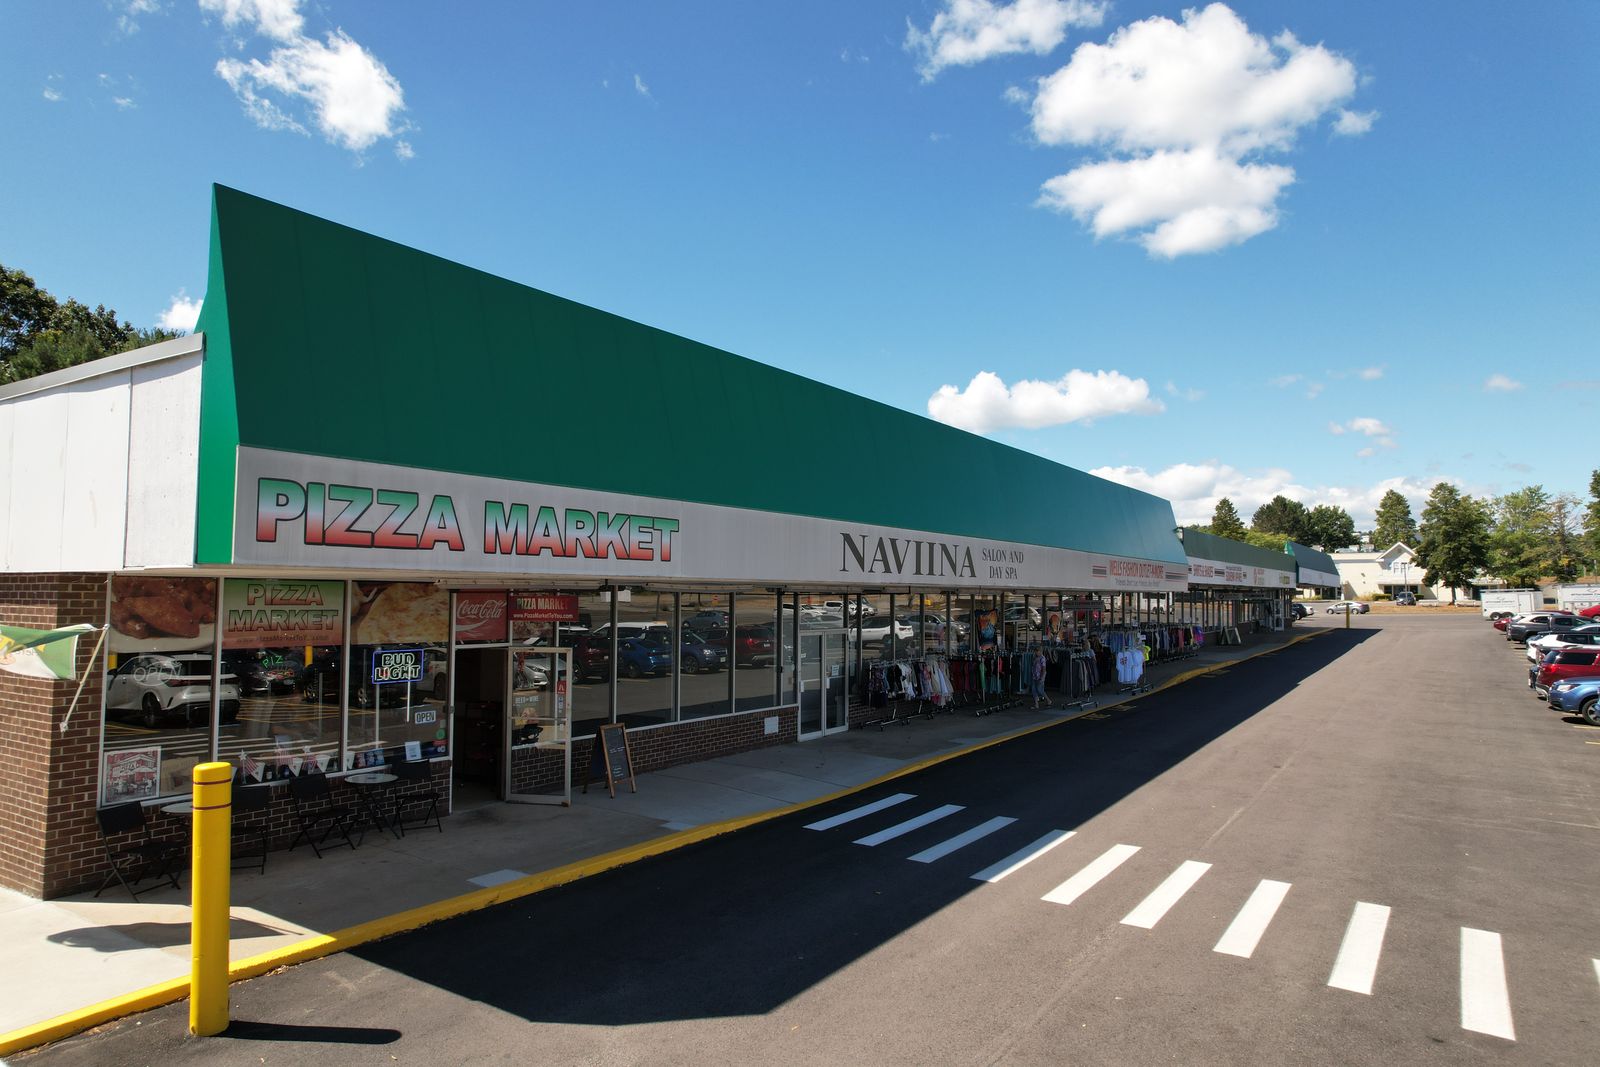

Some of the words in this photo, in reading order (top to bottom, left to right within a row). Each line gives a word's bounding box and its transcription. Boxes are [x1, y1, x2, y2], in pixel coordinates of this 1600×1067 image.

[255, 476, 465, 551] PIZZA
[483, 500, 680, 562] MARKET
[839, 532, 977, 578] NAVIINA
[982, 548, 1007, 562] SALON
[1009, 550, 1024, 564] AND
[989, 566, 1004, 579] DAY
[1005, 566, 1018, 580] SPA
[247, 584, 324, 606] PIZZA
[516, 597, 537, 610] PIZZA
[537, 597, 569, 610] MARKET
[457, 600, 507, 619] Coca-Cola
[228, 609, 339, 632] MARKET
[381, 653, 415, 667] BUD
[374, 664, 421, 681] LIGHT
[415, 712, 435, 723] OPEN
